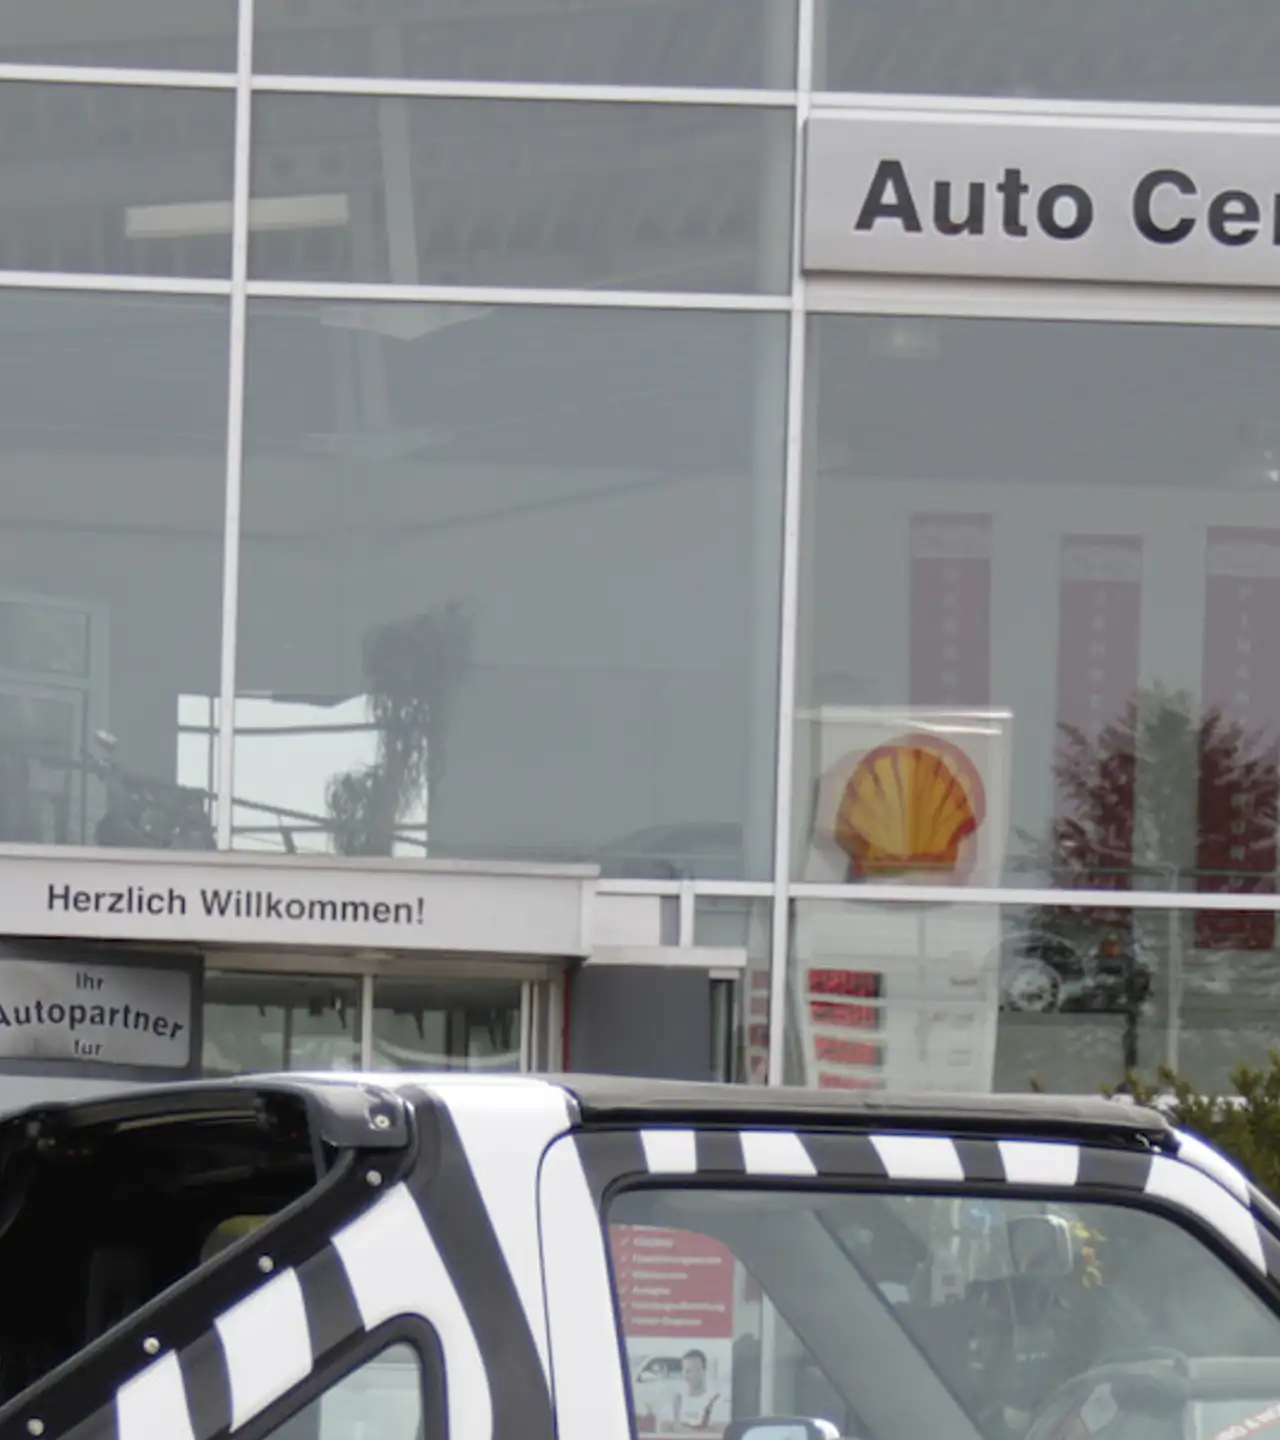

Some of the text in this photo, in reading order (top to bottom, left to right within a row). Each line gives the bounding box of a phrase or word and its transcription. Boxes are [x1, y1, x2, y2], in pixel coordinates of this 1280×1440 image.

[854, 159, 1094, 241] Auto
[47, 884, 425, 925] Herzlich Willkommen!
[75, 971, 105, 991] Ihr
